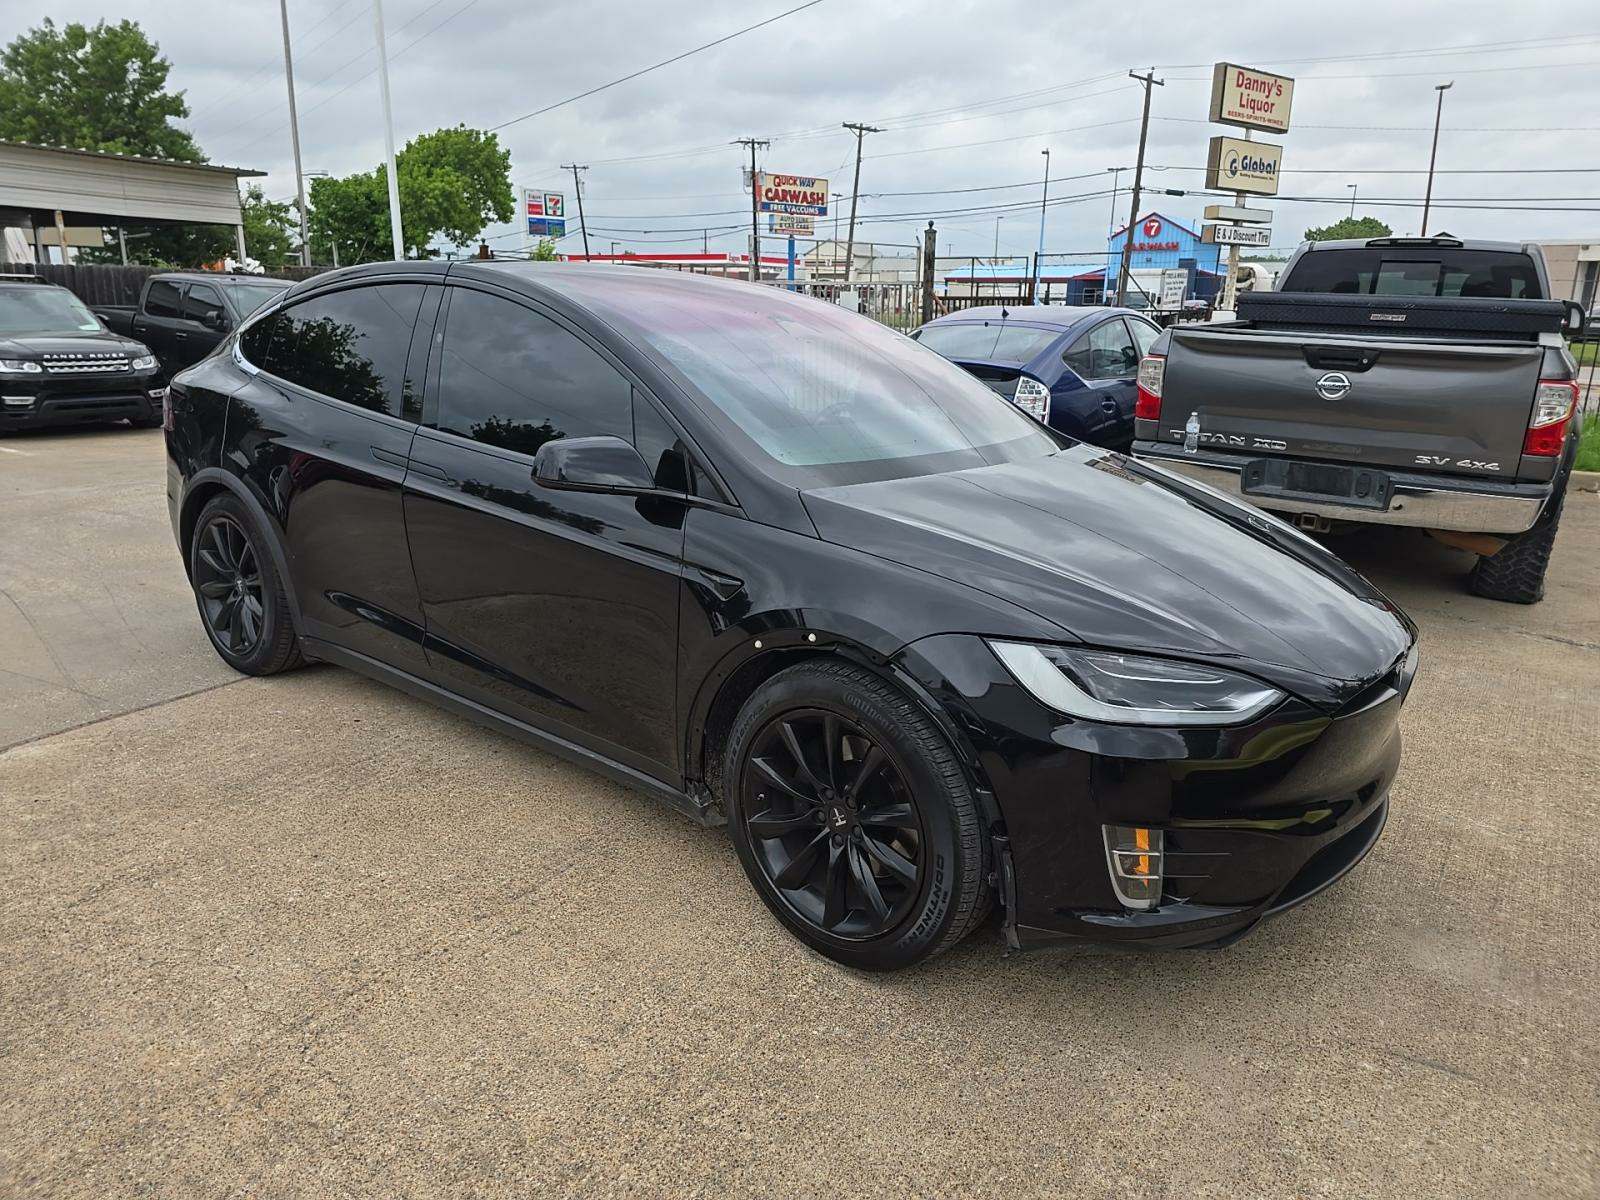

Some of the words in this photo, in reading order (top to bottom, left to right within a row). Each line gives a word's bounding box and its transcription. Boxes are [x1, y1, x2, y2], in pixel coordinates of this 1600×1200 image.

[1236, 71, 1283, 98] Danny's
[1239, 92, 1275, 114] Liquor
[1241, 155, 1277, 175] Global
[773, 175, 798, 187] QUICK
[799, 177, 816, 188] WAY
[765, 188, 824, 205] CARWASH
[770, 203, 785, 211] FREE
[786, 205, 819, 215] VACCUMS
[1216, 228, 1221, 240] E
[1222, 227, 1227, 240] &
[1228, 230, 1233, 240] J
[1233, 229, 1257, 243] Discount
[1258, 231, 1269, 243] Tire
[1253, 438, 1287, 450] XD
[1415, 455, 1450, 466] SV
